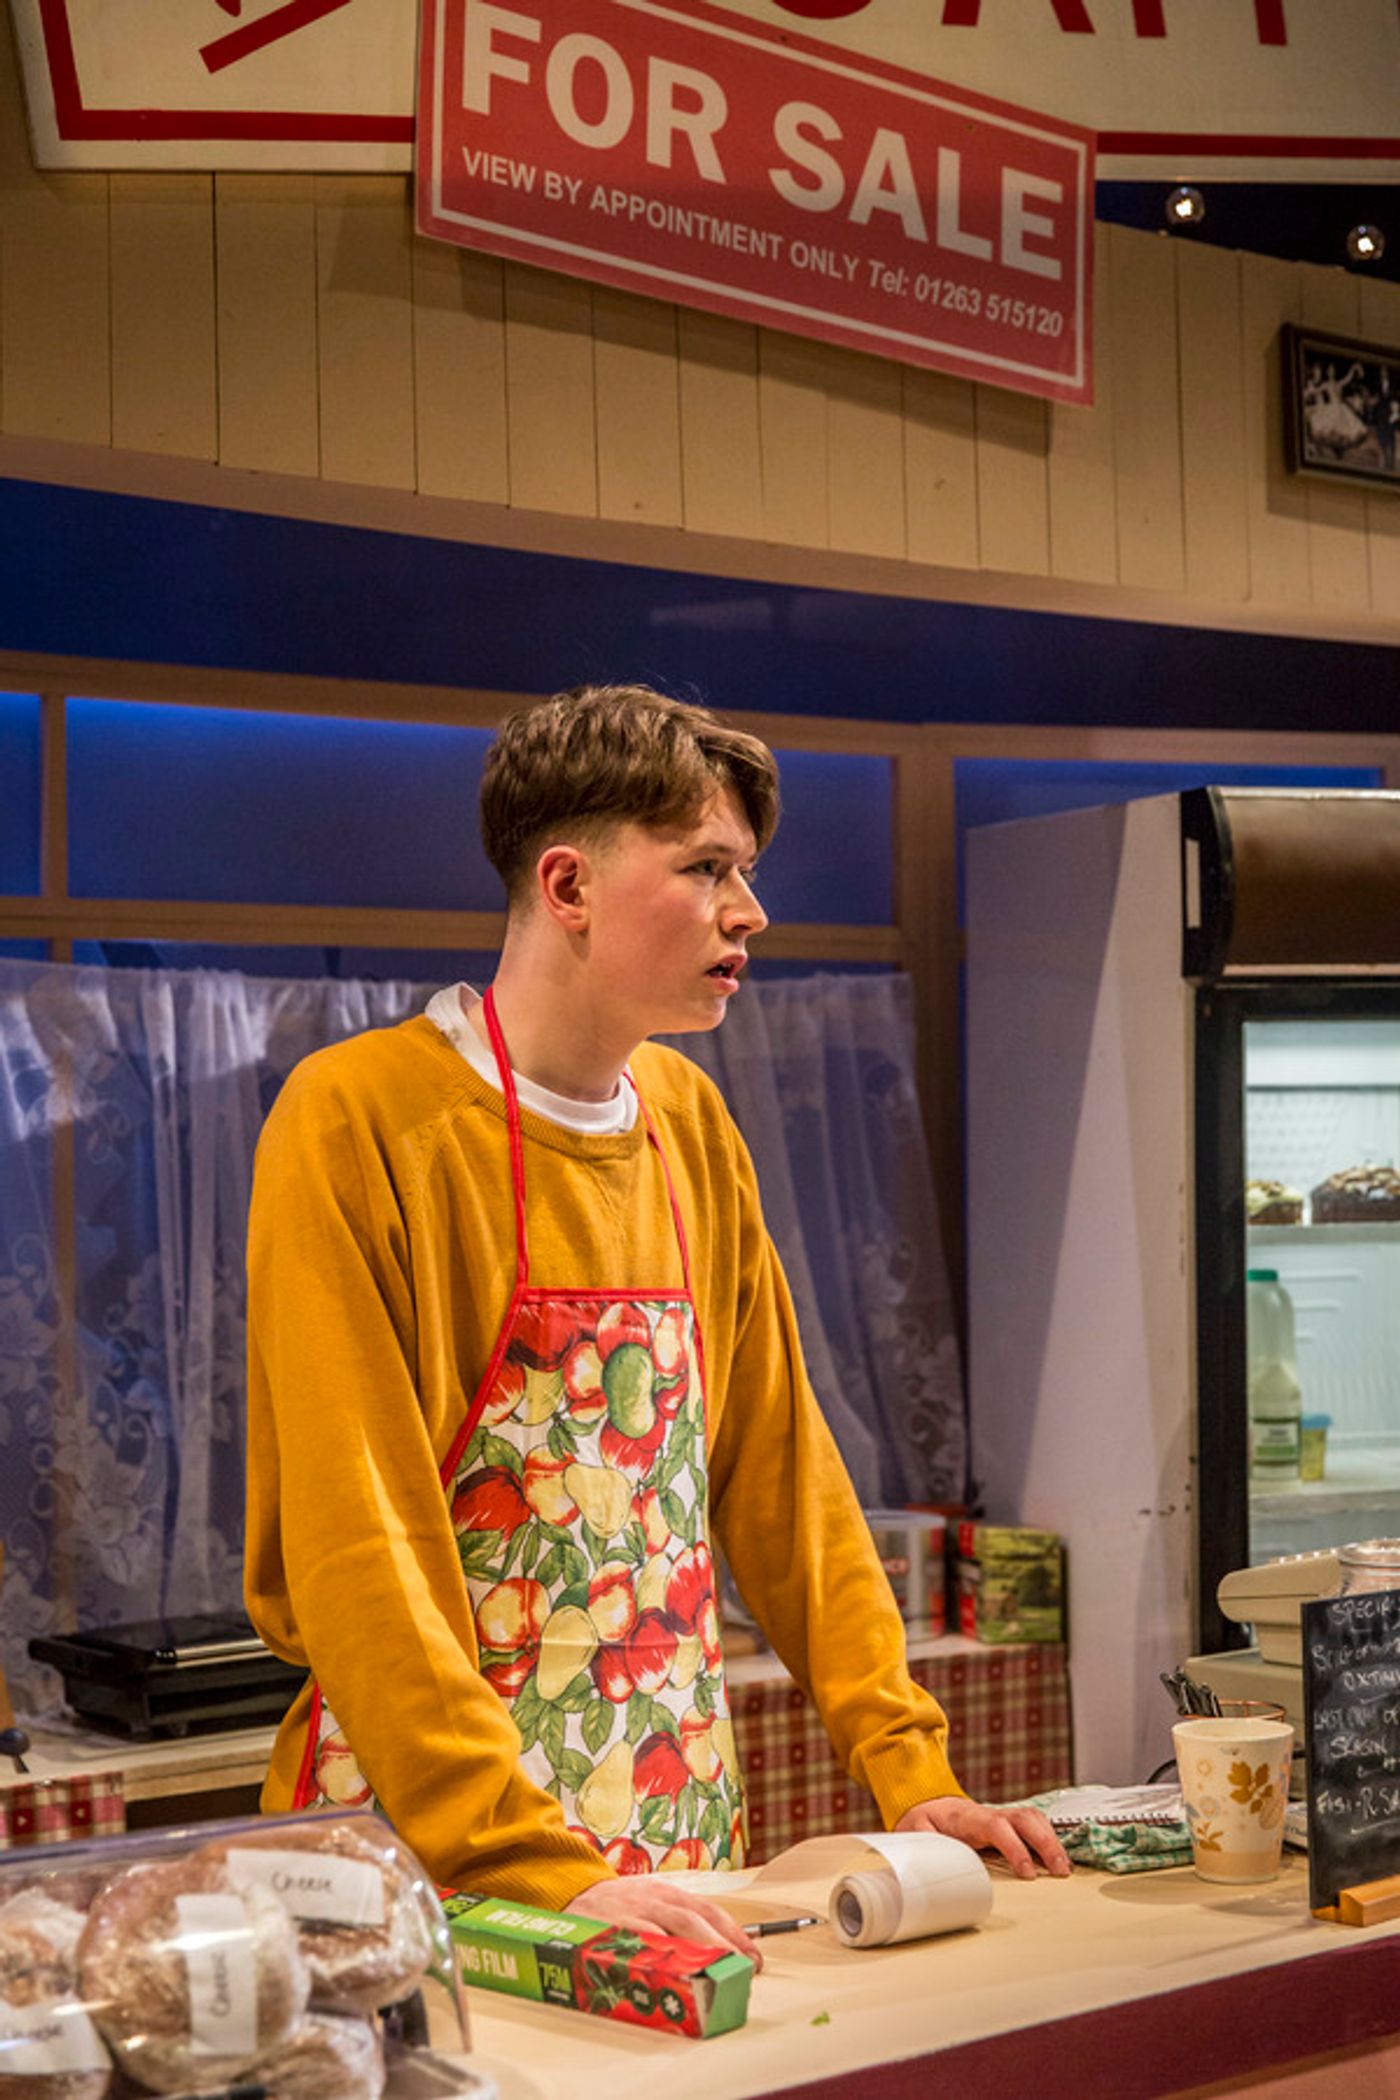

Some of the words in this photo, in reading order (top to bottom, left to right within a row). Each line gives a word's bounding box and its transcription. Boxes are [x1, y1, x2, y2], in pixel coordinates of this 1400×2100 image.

[461, 0, 727, 185] FOR
[767, 101, 1063, 281] SALE
[461, 147, 537, 193] VIEW
[543, 171, 583, 204] BY
[589, 185, 784, 261] APPOINTMENT
[789, 241, 861, 282] ONLY
[867, 260, 909, 297] Tel:
[913, 279, 981, 318] 01263
[986, 295, 1064, 337] 515120
[481, 1947, 520, 1980] FILM
